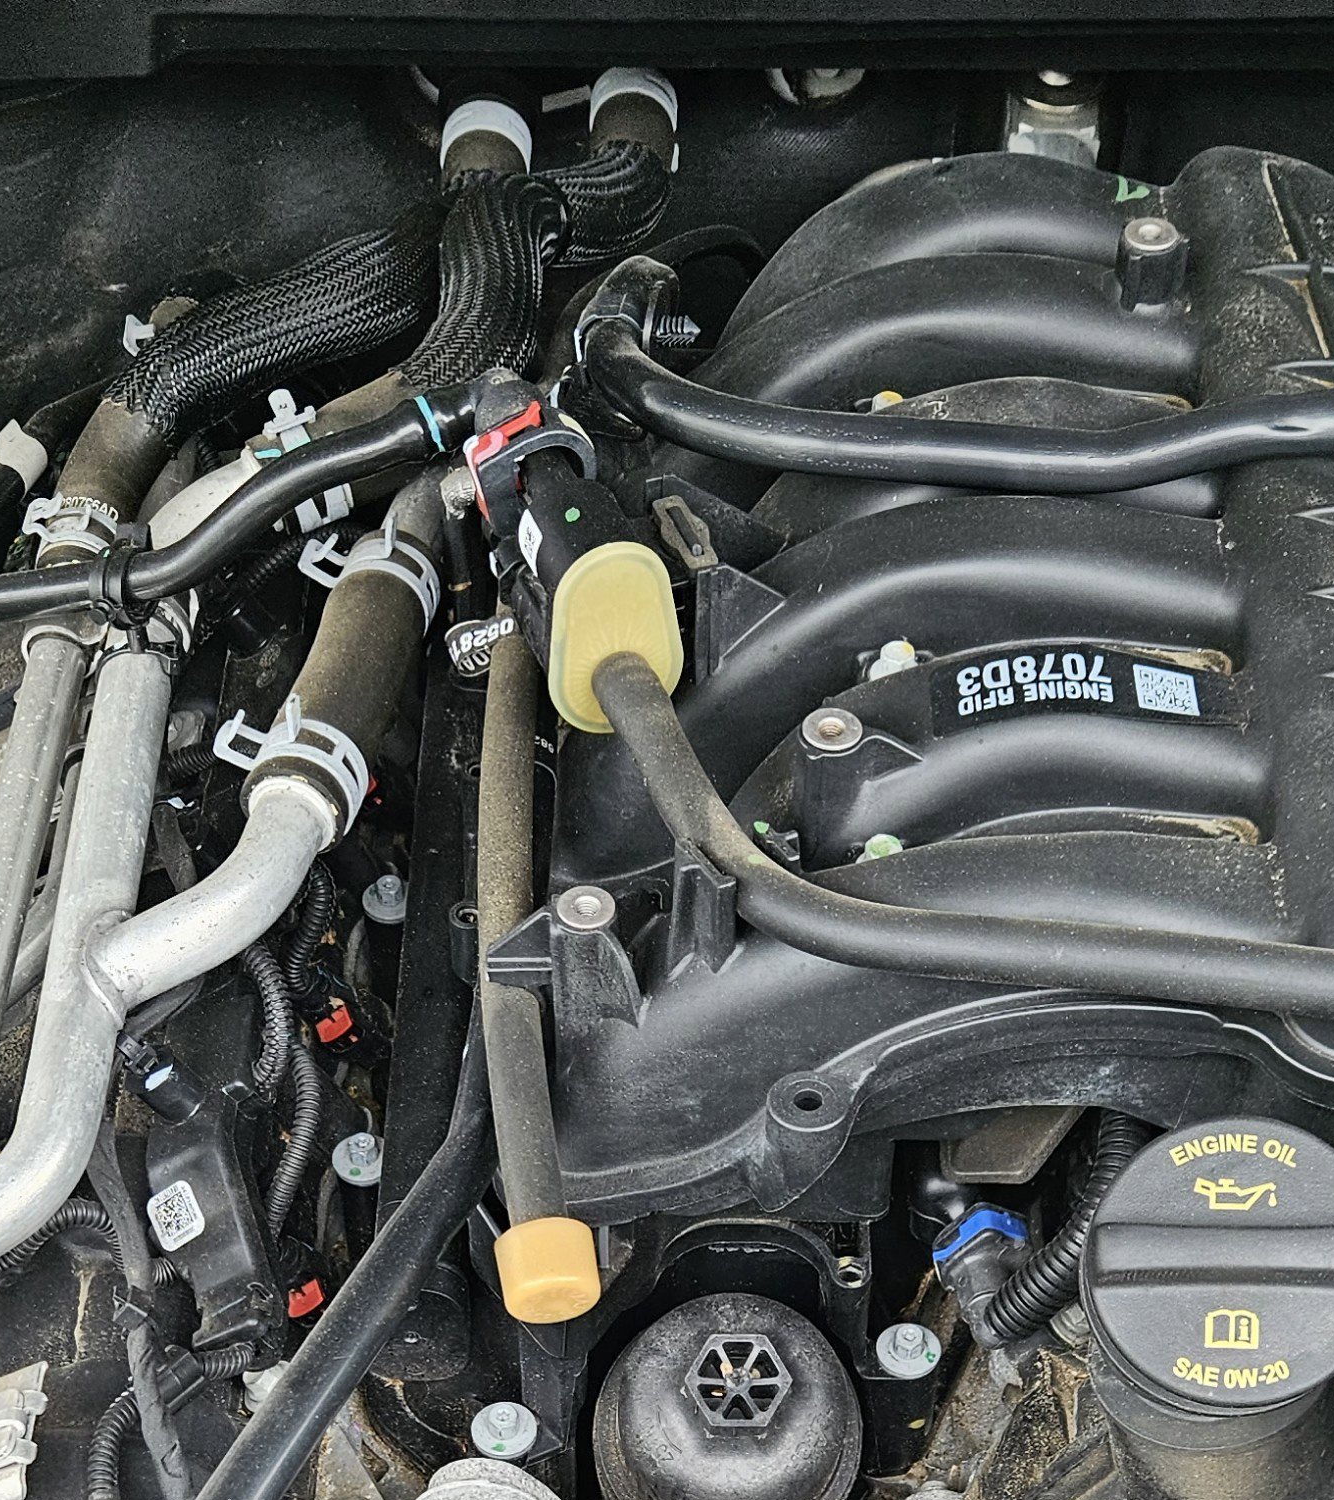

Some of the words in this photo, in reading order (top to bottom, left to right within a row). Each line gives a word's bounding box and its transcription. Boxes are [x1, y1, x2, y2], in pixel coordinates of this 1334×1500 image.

[956, 652, 1113, 697] 7078D3
[957, 685, 1015, 717] RFID
[1023, 680, 1115, 704] ENGINE
[1168, 1132, 1258, 1167] ENGINE
[1262, 1138, 1297, 1168] OIL
[1172, 1357, 1220, 1388] SAE
[1223, 1359, 1290, 1389] 0W-20
